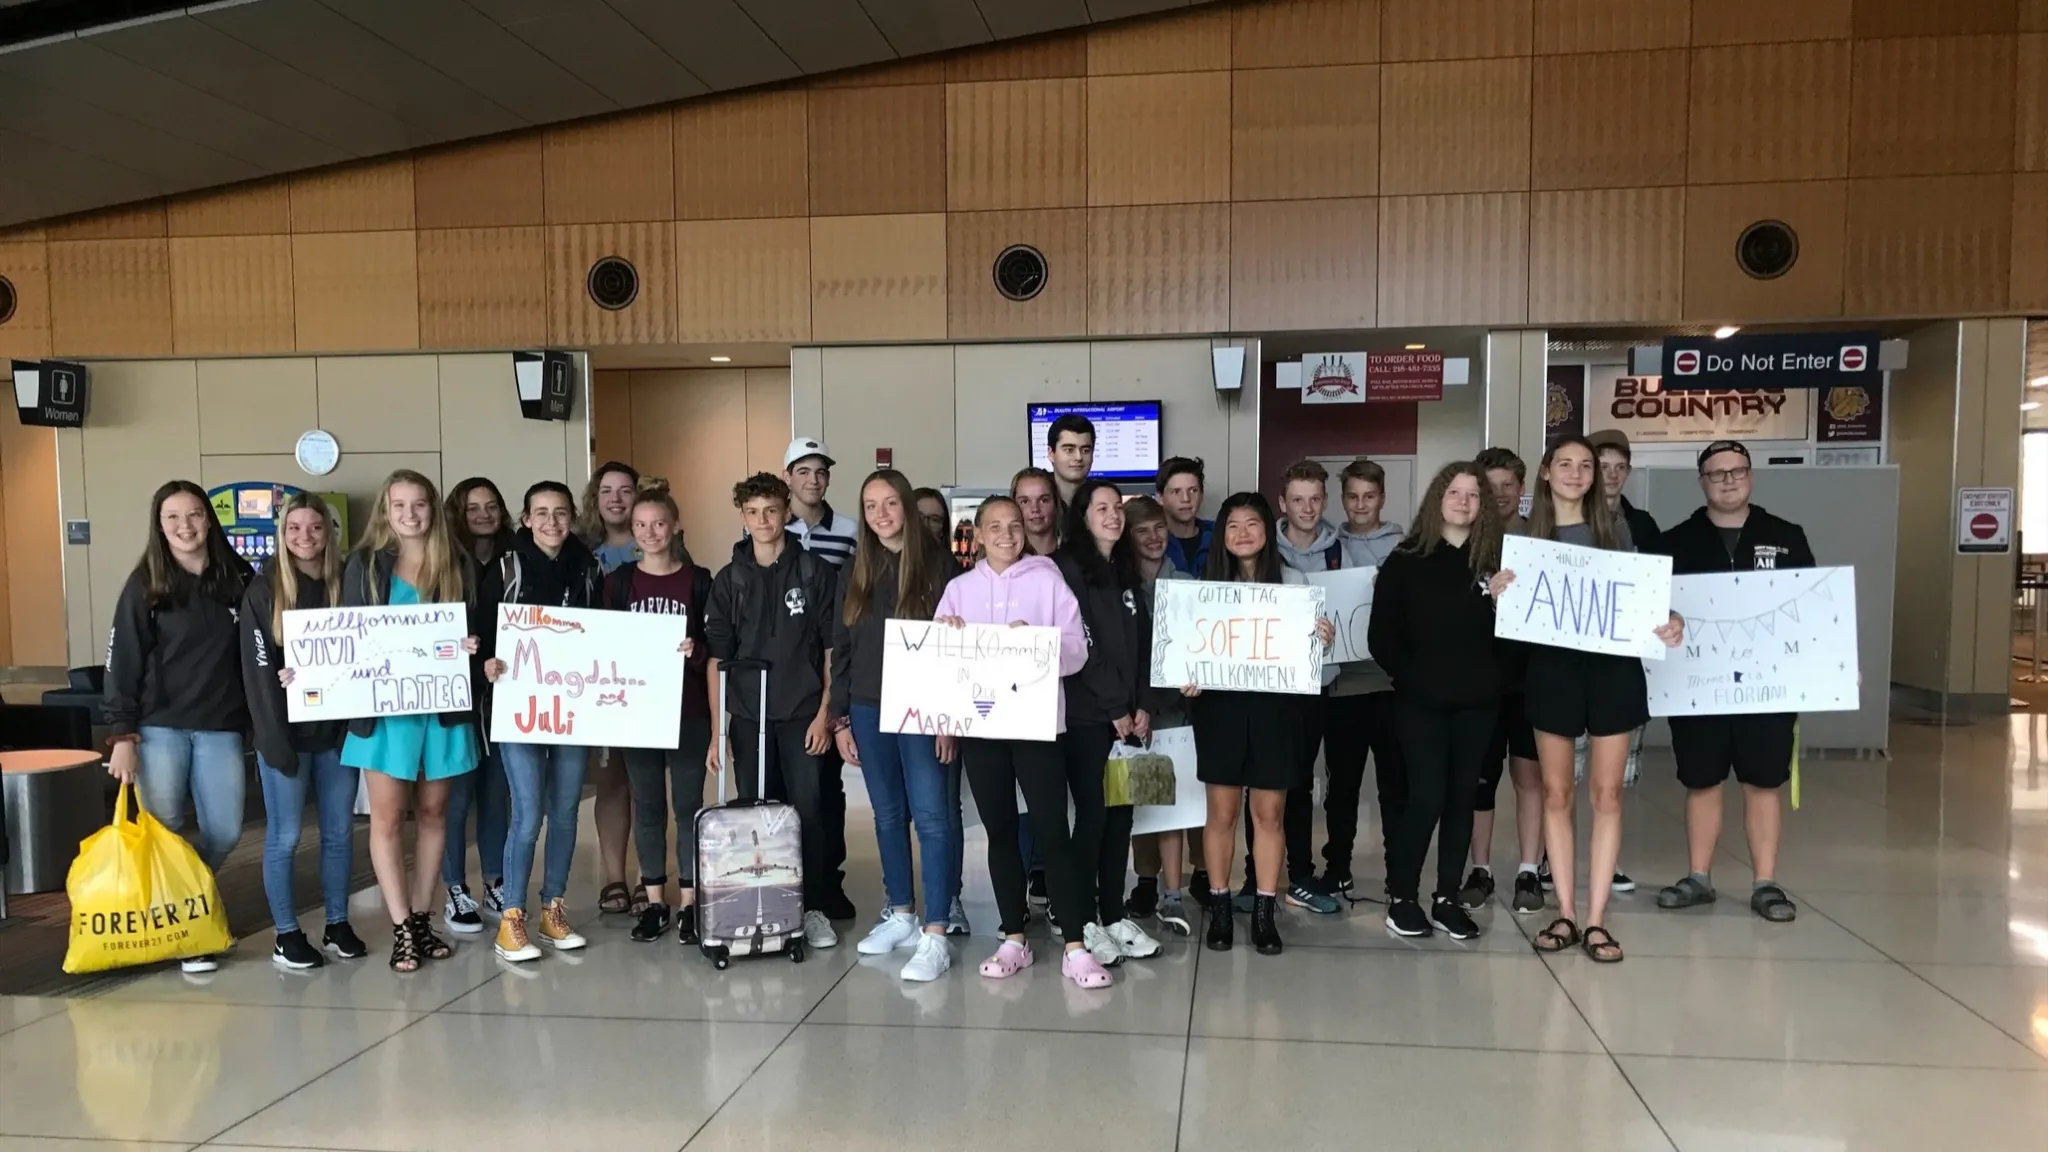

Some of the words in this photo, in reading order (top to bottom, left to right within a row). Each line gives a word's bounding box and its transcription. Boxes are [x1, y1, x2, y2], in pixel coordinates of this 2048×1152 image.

[1369, 355, 1381, 364] TO
[1383, 354, 1415, 364] ORDER
[1416, 353, 1441, 363] FOOD
[1706, 354, 1733, 372] Do
[1741, 353, 1775, 371] Not
[1782, 352, 1834, 370] Enter
[44, 406, 79, 421] Women
[550, 399, 564, 413] Men
[1611, 395, 1787, 420] COUNTRY
[1198, 587, 1242, 605] GUTEN
[1251, 587, 1278, 604] TAG
[1525, 570, 1635, 642] ANNE
[303, 609, 455, 640] willkommen
[291, 635, 355, 667] VIVI
[1186, 618, 1281, 661] SOFIE
[1685, 646, 1700, 659] M
[1784, 641, 1800, 655] M
[350, 659, 393, 681] und
[1186, 661, 1296, 689] WILLKOMMEN!
[372, 673, 471, 713] MATEA
[514, 695, 575, 736] Juli
[79, 903, 181, 936] FOREVER
[184, 893, 210, 921] 21
